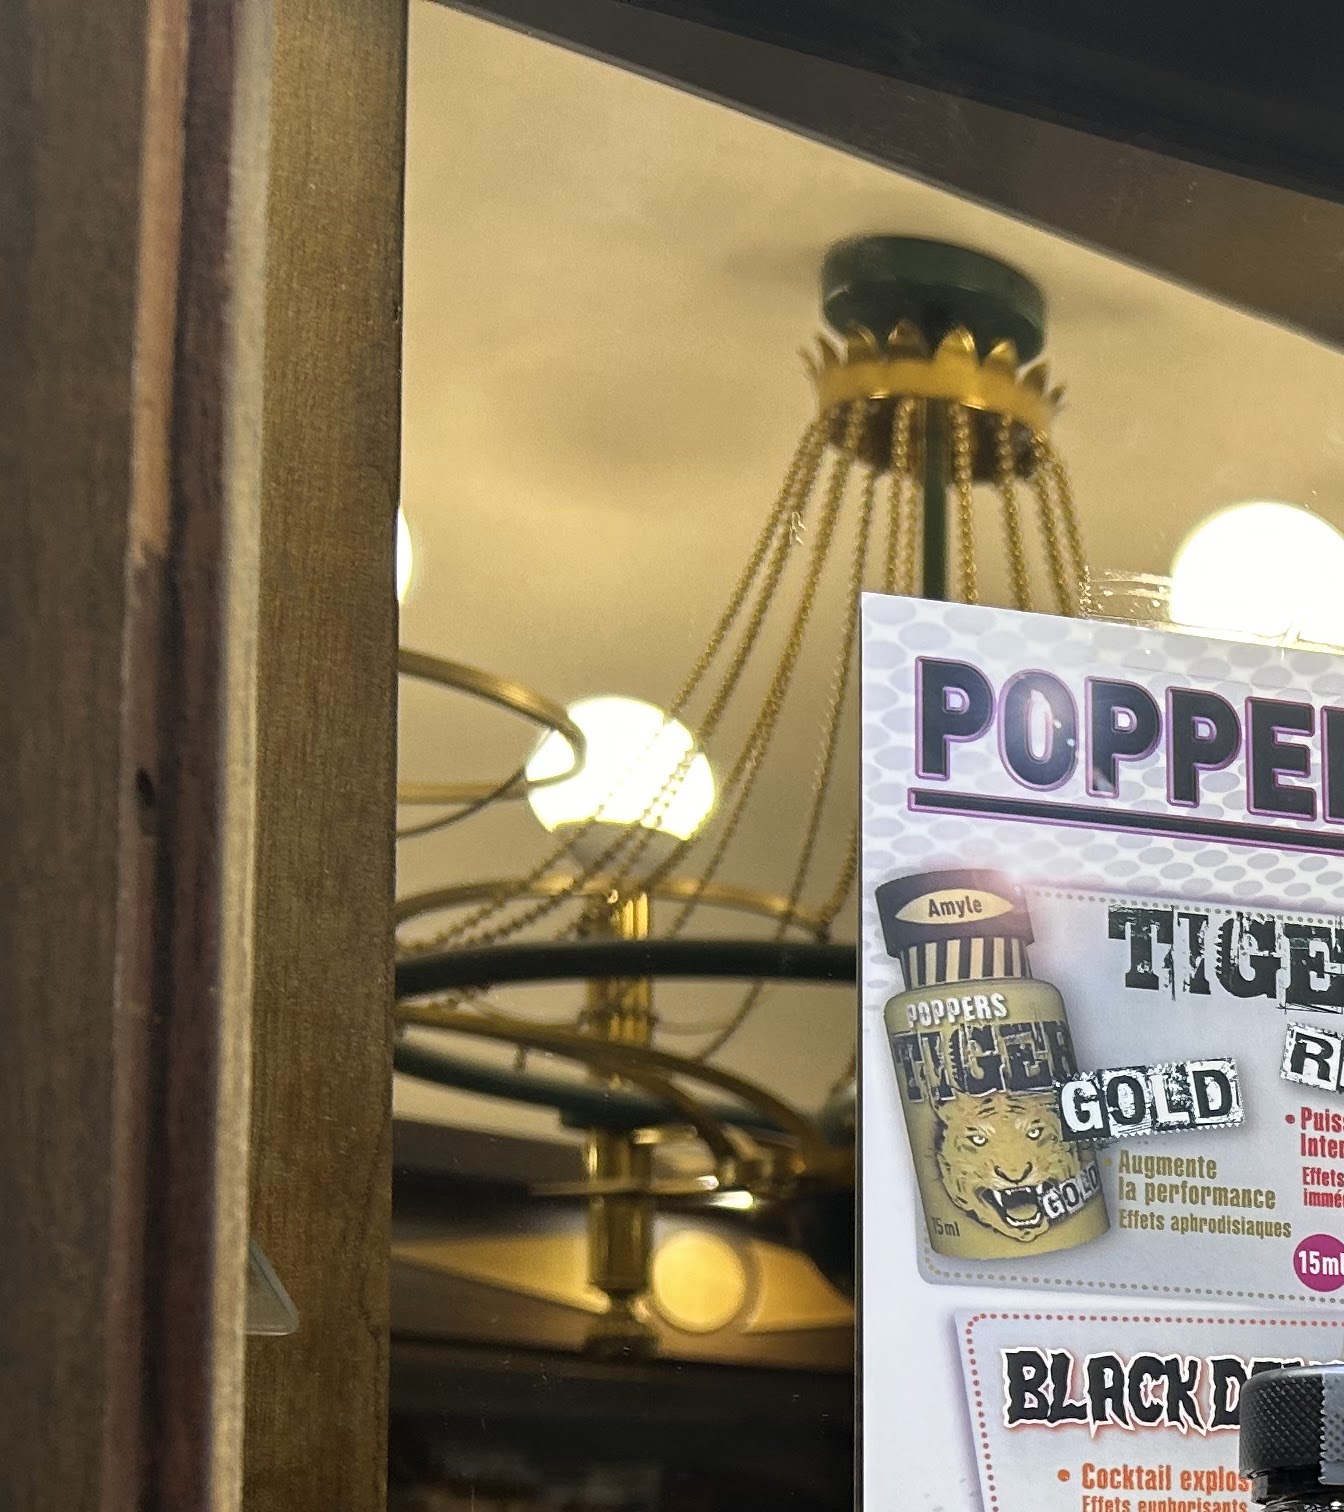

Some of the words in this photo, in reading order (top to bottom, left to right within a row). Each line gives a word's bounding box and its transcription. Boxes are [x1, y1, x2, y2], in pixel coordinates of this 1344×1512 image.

[928, 897, 982, 919] Amyle
[1058, 1058, 1244, 1141] GOLD
[1119, 1149, 1217, 1182] Augmente
[1302, 1166, 1344, 1188] Effets
[1119, 1178, 1137, 1201] la
[1143, 1181, 1276, 1210] performance
[1119, 1208, 1165, 1230] Effets
[1170, 1212, 1292, 1239] aphrodisiaques
[1003, 1348, 1204, 1435] BLACK
[1082, 1461, 1171, 1496] Cocktail
